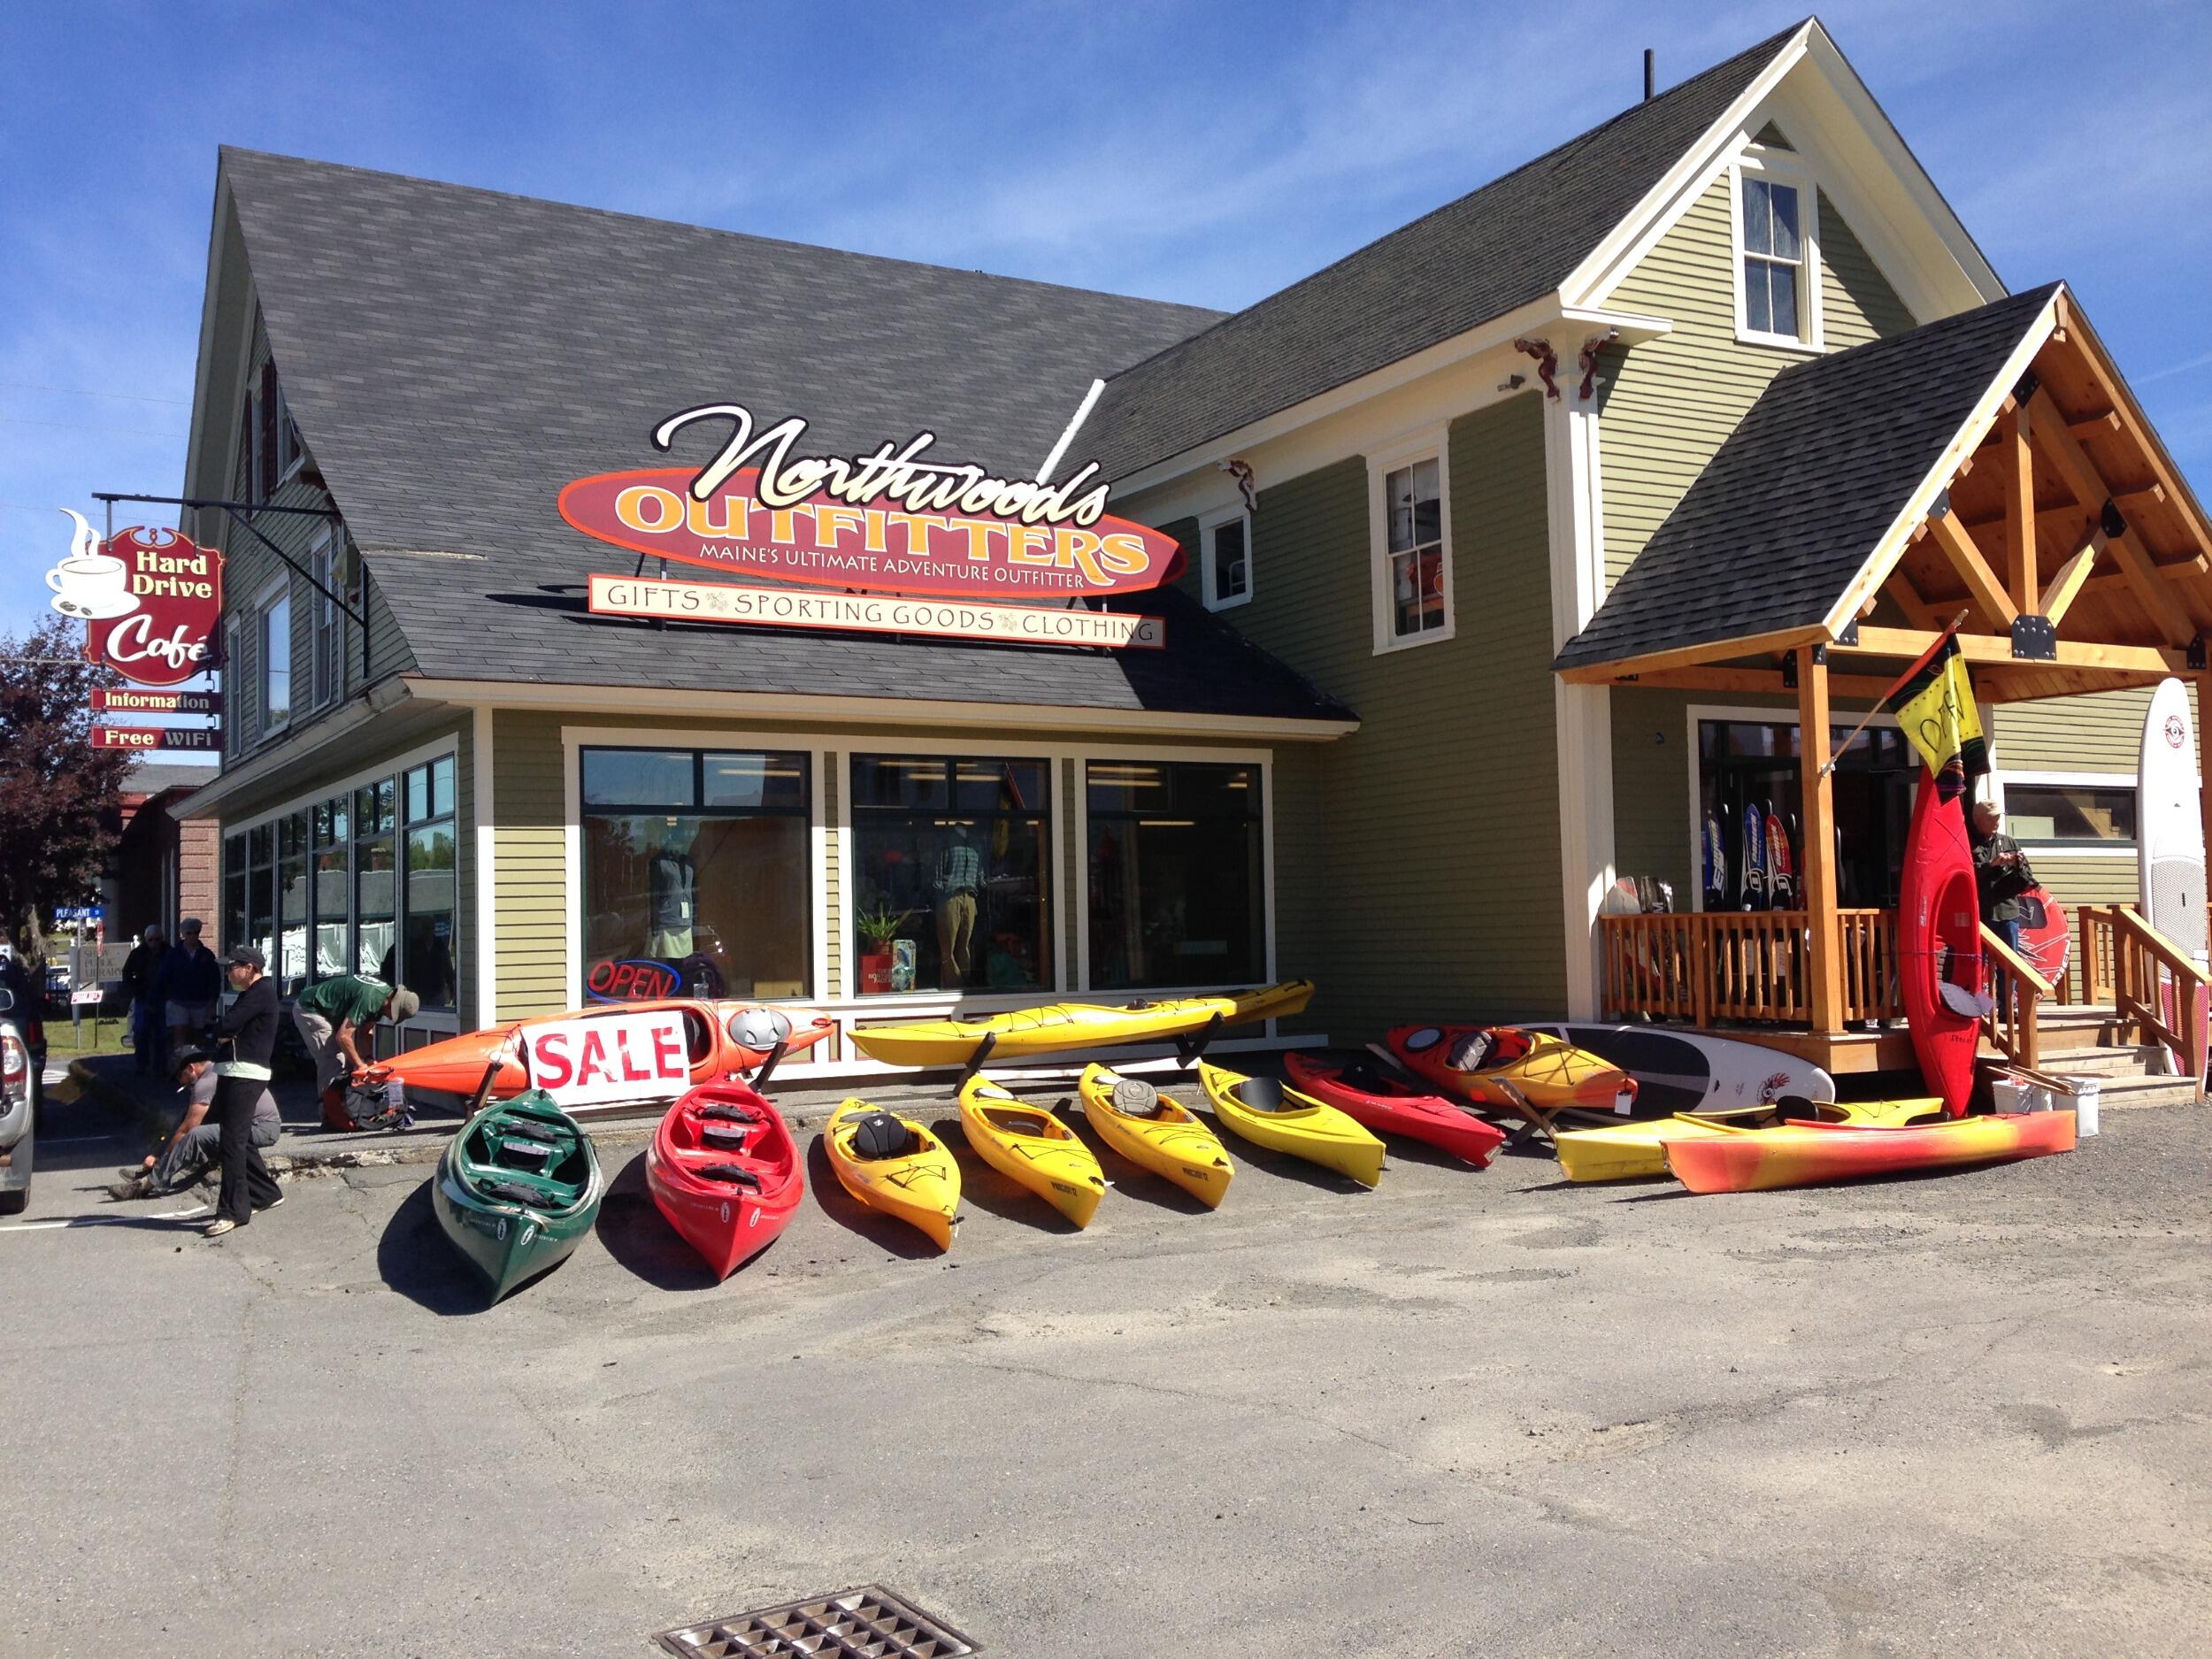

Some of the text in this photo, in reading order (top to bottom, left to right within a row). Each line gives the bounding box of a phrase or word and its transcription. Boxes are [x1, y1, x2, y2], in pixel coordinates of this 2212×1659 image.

[652, 403, 1110, 526] Northwoods
[614, 485, 1150, 588] OUTFITTERS
[136, 550, 208, 575] Hard
[699, 542, 1085, 588] MAINE'S ULTIMATE ADVENTURE OUTFITTER
[133, 573, 213, 599] Drive
[607, 585, 1154, 641] GIFTS SPORTING GOODS CLOTHING
[106, 614, 212, 670] Café
[104, 692, 210, 709] Information
[104, 729, 212, 747] Free WiFi
[56, 908, 90, 918] PLEASANT
[588, 960, 674, 1001] OPEN
[534, 1025, 684, 1089] SALE
